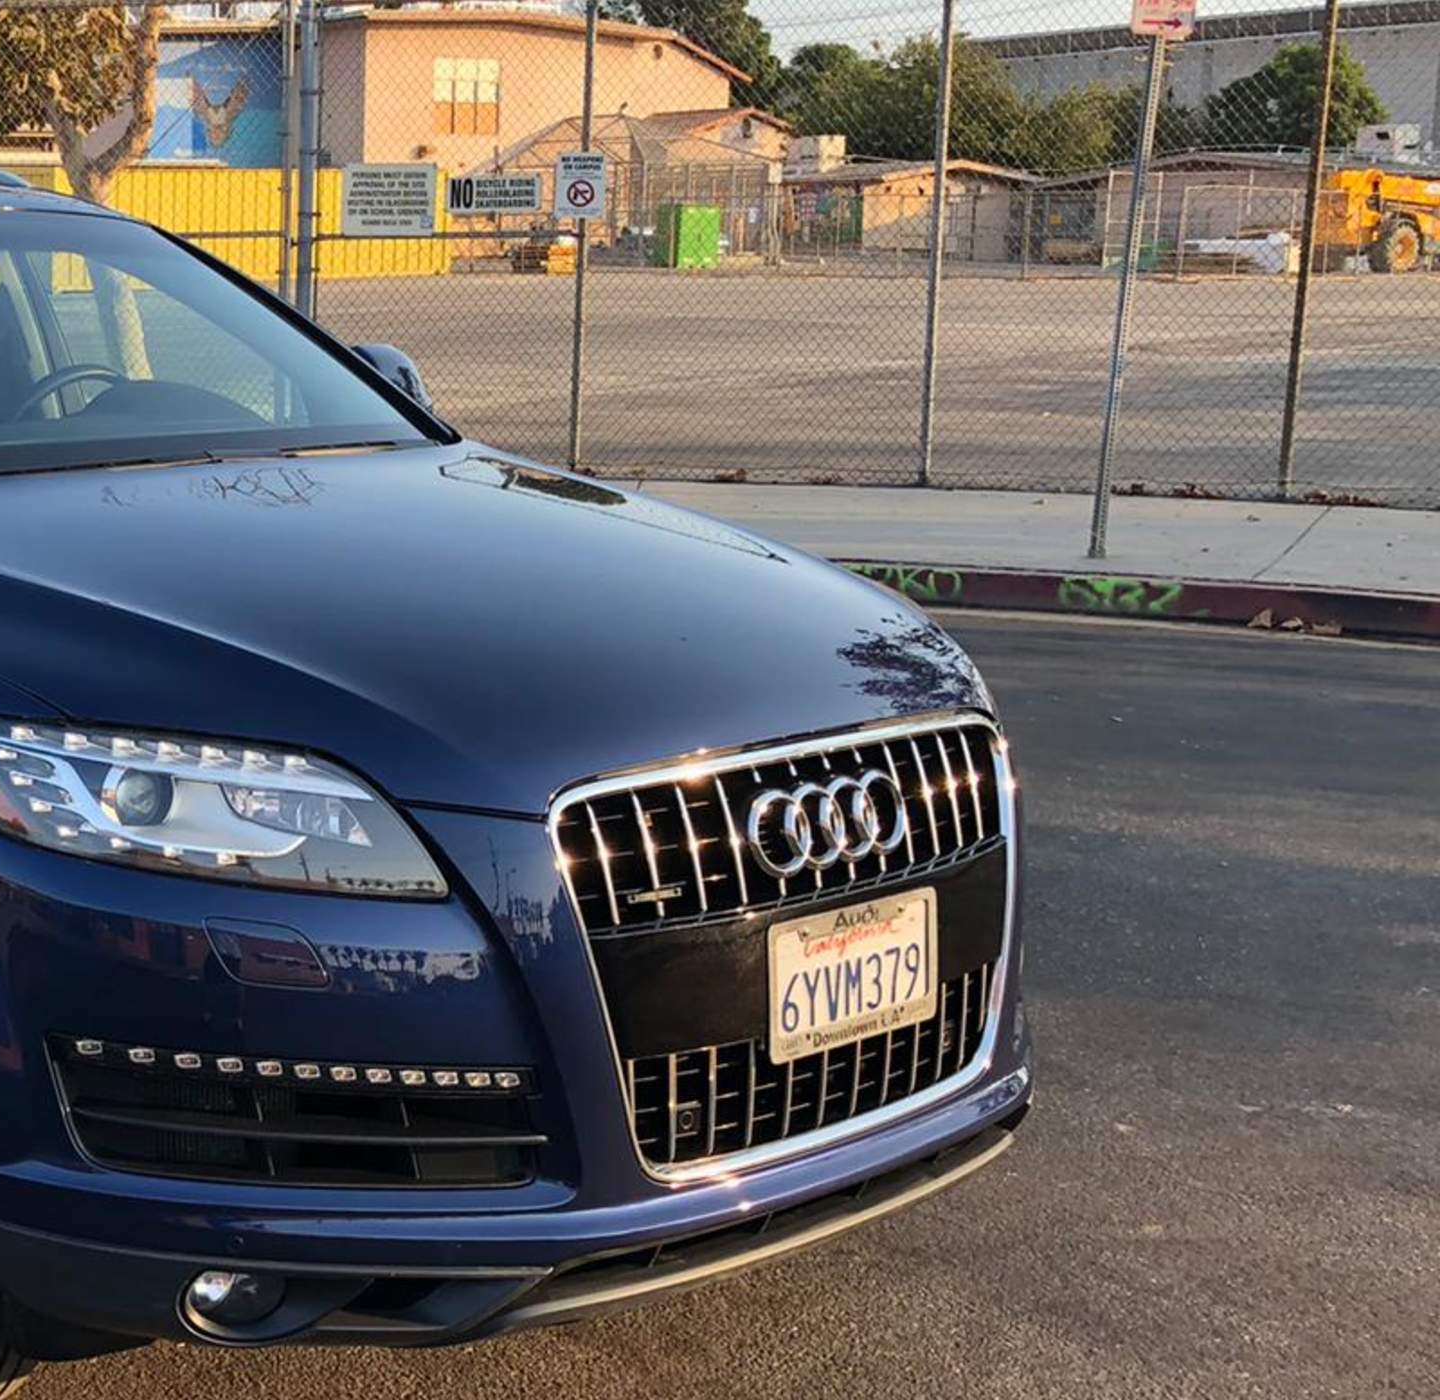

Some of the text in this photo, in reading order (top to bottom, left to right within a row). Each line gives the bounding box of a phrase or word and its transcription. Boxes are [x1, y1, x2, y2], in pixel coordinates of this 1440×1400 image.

[476, 179, 535, 187] BICYCLE RIDING
[450, 179, 473, 209] NO
[476, 189, 535, 197] ROLLERBLADING
[475, 199, 535, 208] SKATEBOARDING
[834, 904, 879, 928] Audi
[782, 943, 920, 1033] 6YVM379
